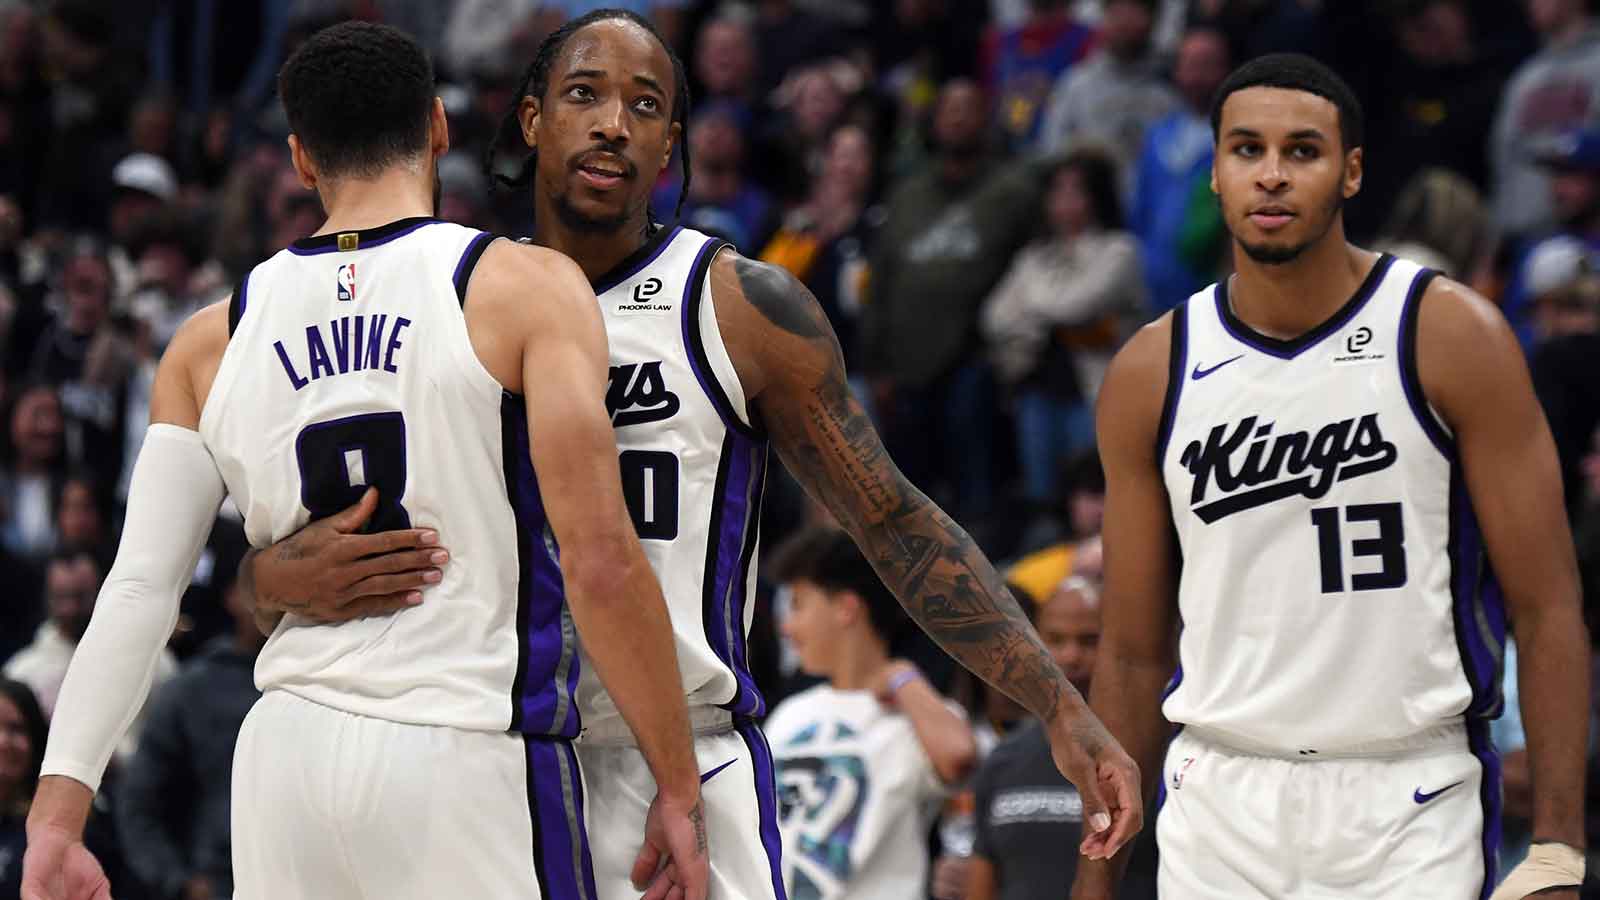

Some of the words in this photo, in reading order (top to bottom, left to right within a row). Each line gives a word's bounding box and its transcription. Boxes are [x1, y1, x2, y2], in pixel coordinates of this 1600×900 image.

[273, 314, 411, 391] LAVINE
[619, 450, 679, 540] 0
[1180, 413, 1397, 525] Kings
[1311, 502, 1407, 594] 13
